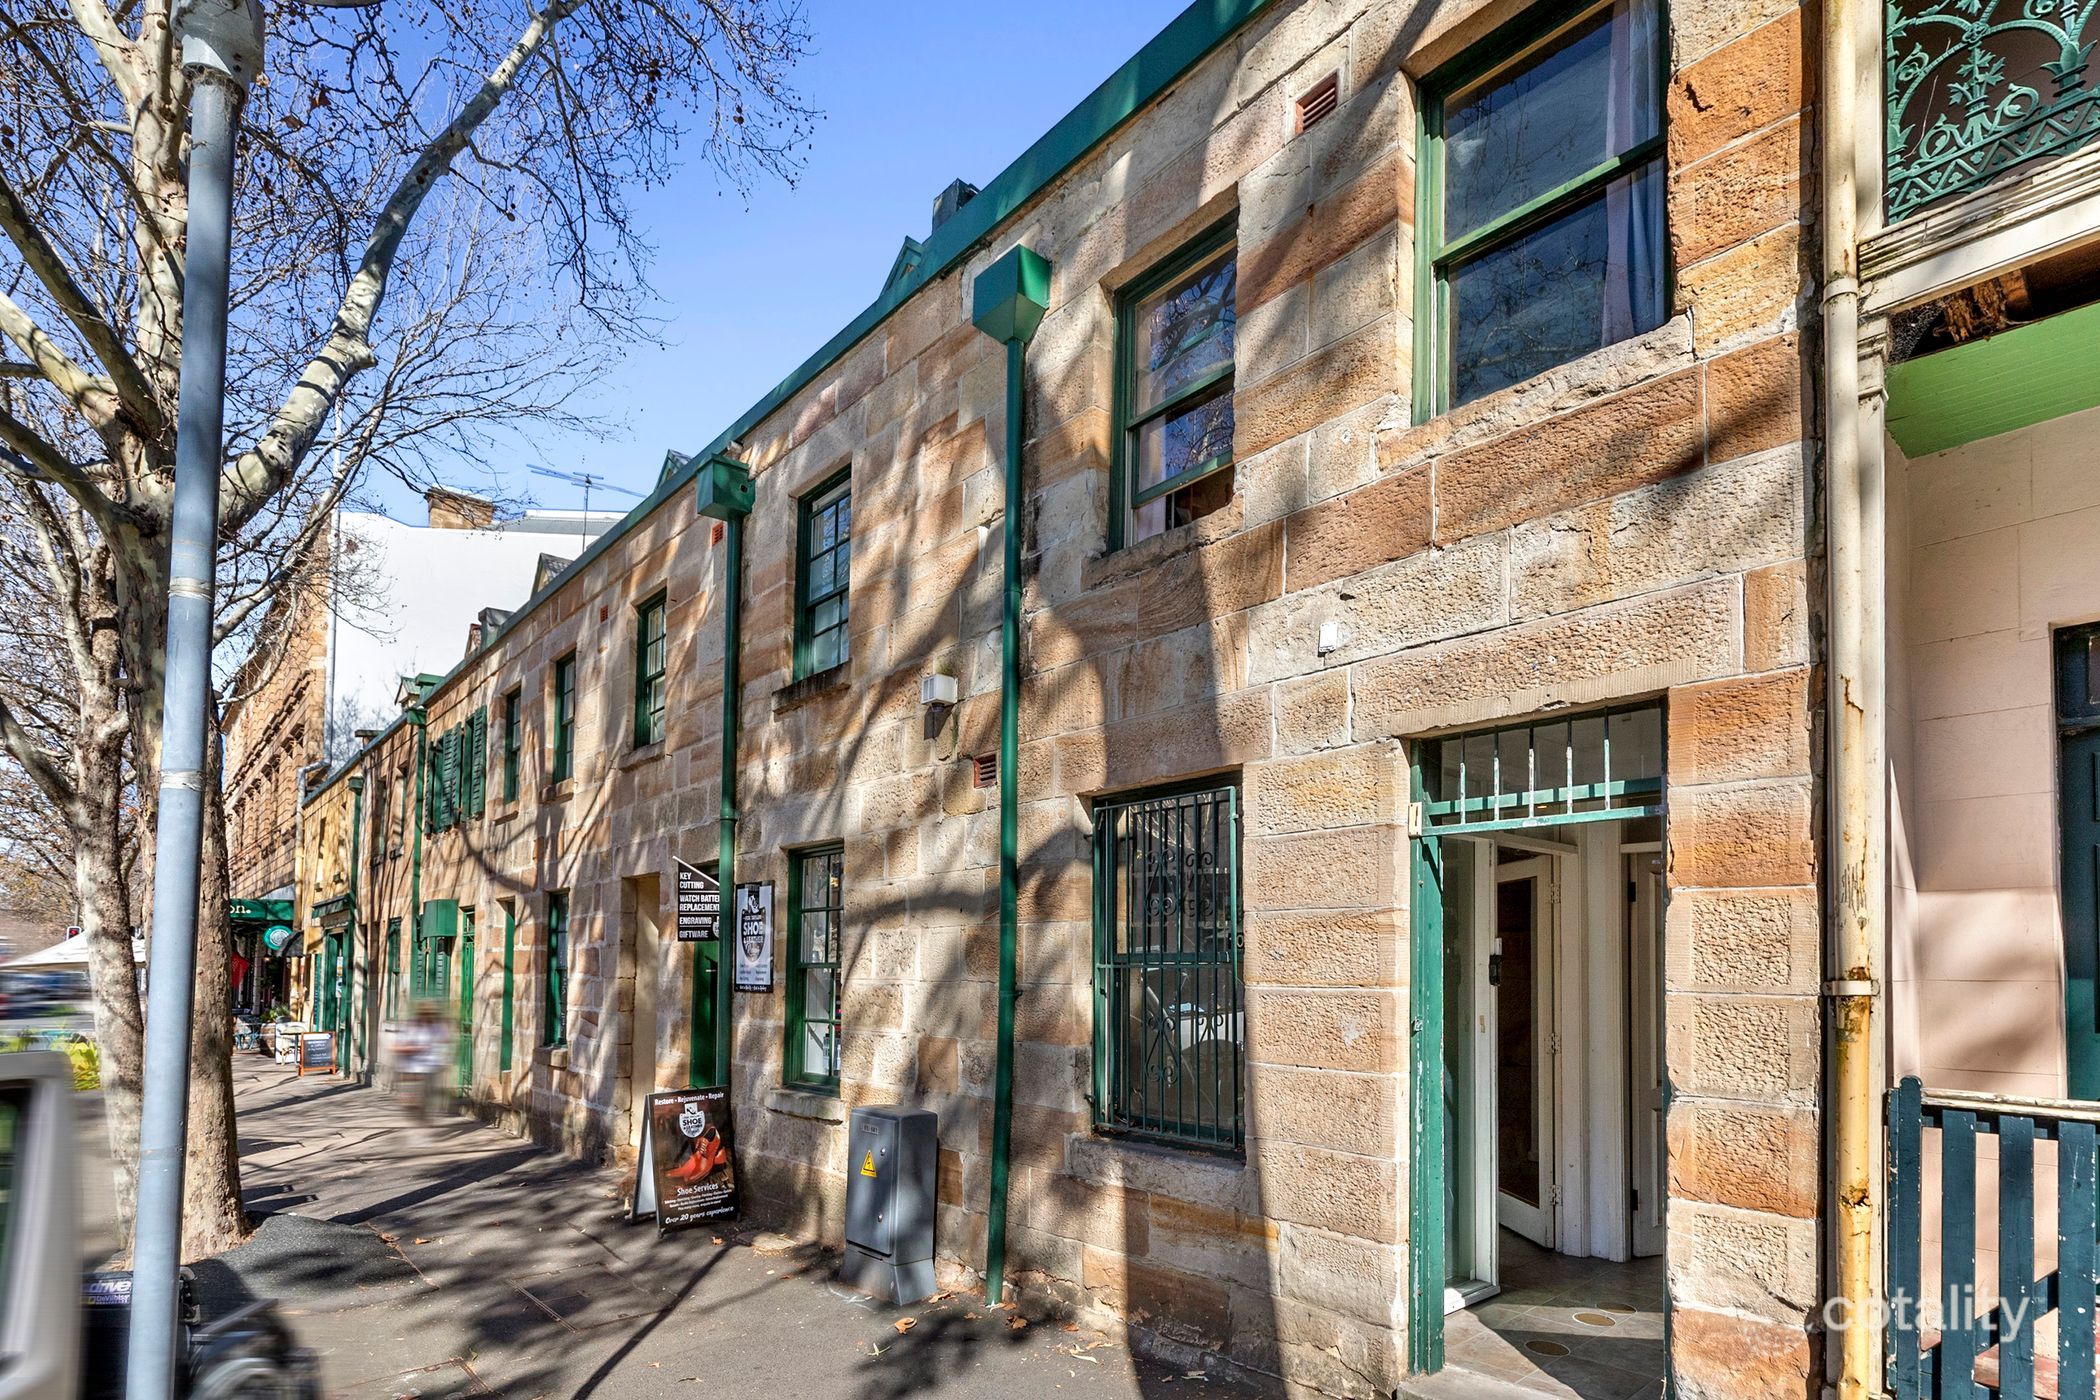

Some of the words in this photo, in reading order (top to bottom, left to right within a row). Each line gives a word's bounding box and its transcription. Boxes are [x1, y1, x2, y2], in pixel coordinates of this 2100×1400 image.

[679, 872, 692, 880] KEY
[679, 881, 704, 889] CUTTING
[679, 894, 700, 903] WATCH
[701, 894, 720, 903] BATTE
[679, 916, 712, 925] ENGRAVING
[743, 921, 765, 936] SHOE
[679, 930, 709, 939] GIFTWARE
[654, 1098, 674, 1106] Restore
[677, 1094, 705, 1103] Rejuvenate
[708, 1091, 724, 1100] Repair
[682, 1117, 702, 1126] SHOE
[677, 1186, 693, 1196] Shoe
[693, 1183, 719, 1193] Services
[679, 1213, 689, 1221] 20
[690, 1211, 706, 1222] years
[90, 1280, 132, 1293] drive
